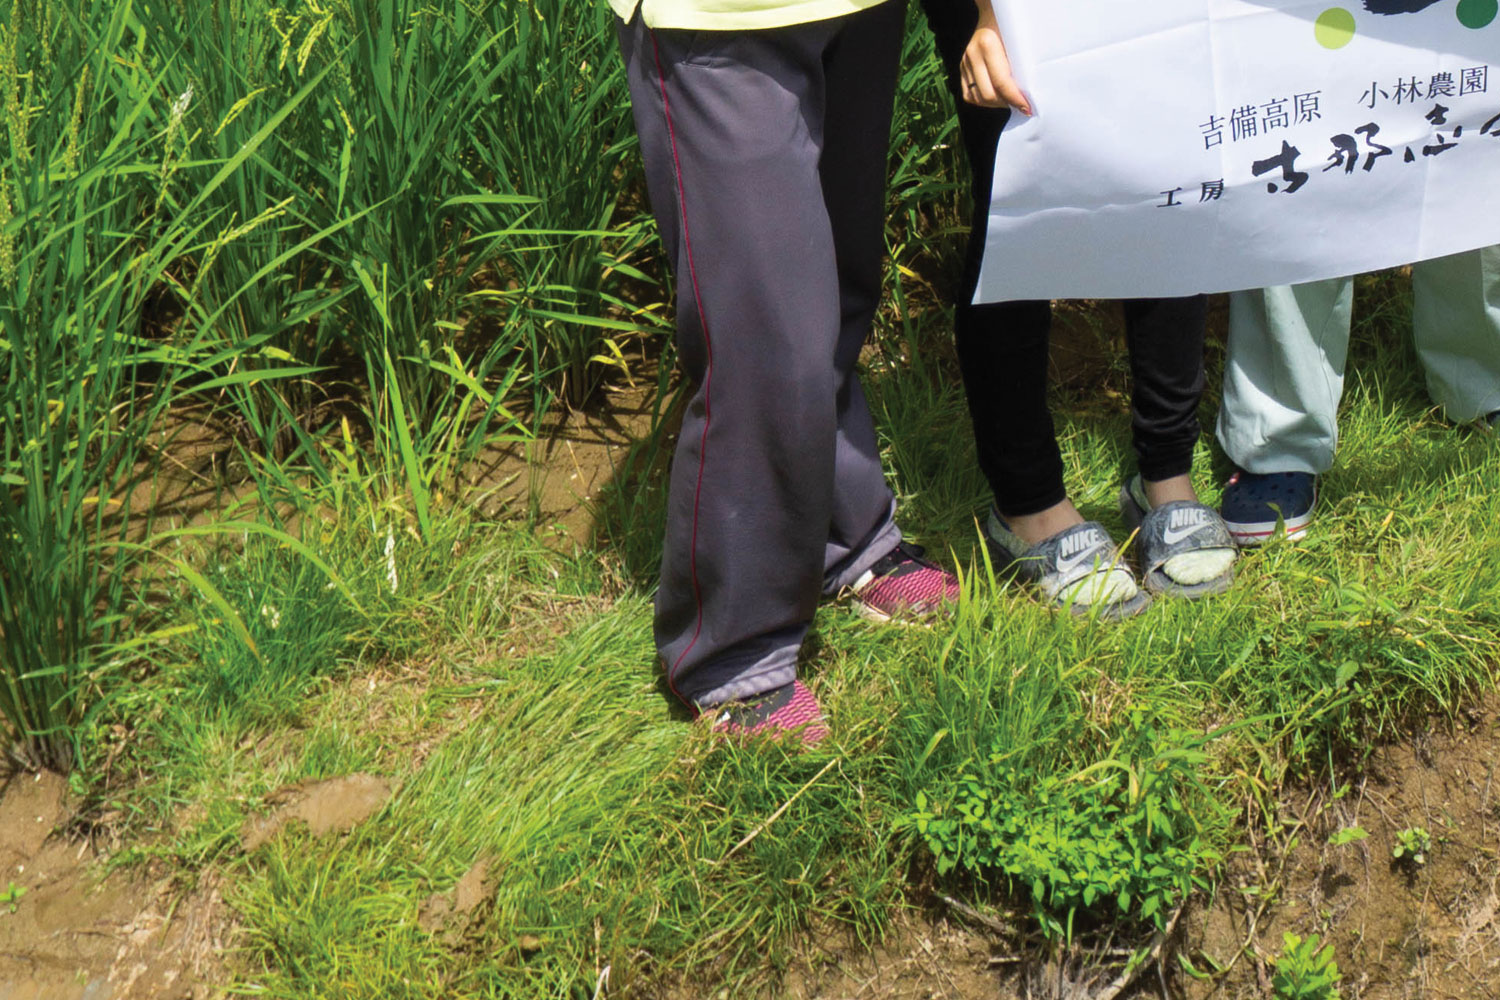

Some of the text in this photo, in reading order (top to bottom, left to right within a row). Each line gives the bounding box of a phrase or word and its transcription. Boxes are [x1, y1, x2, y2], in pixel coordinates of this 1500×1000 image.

[1199, 66, 1488, 150] 吉備高原 小林農園
[1157, 178, 1224, 208] 工房
[1170, 509, 1207, 528] NIKE
[1060, 528, 1100, 557] NIKE
